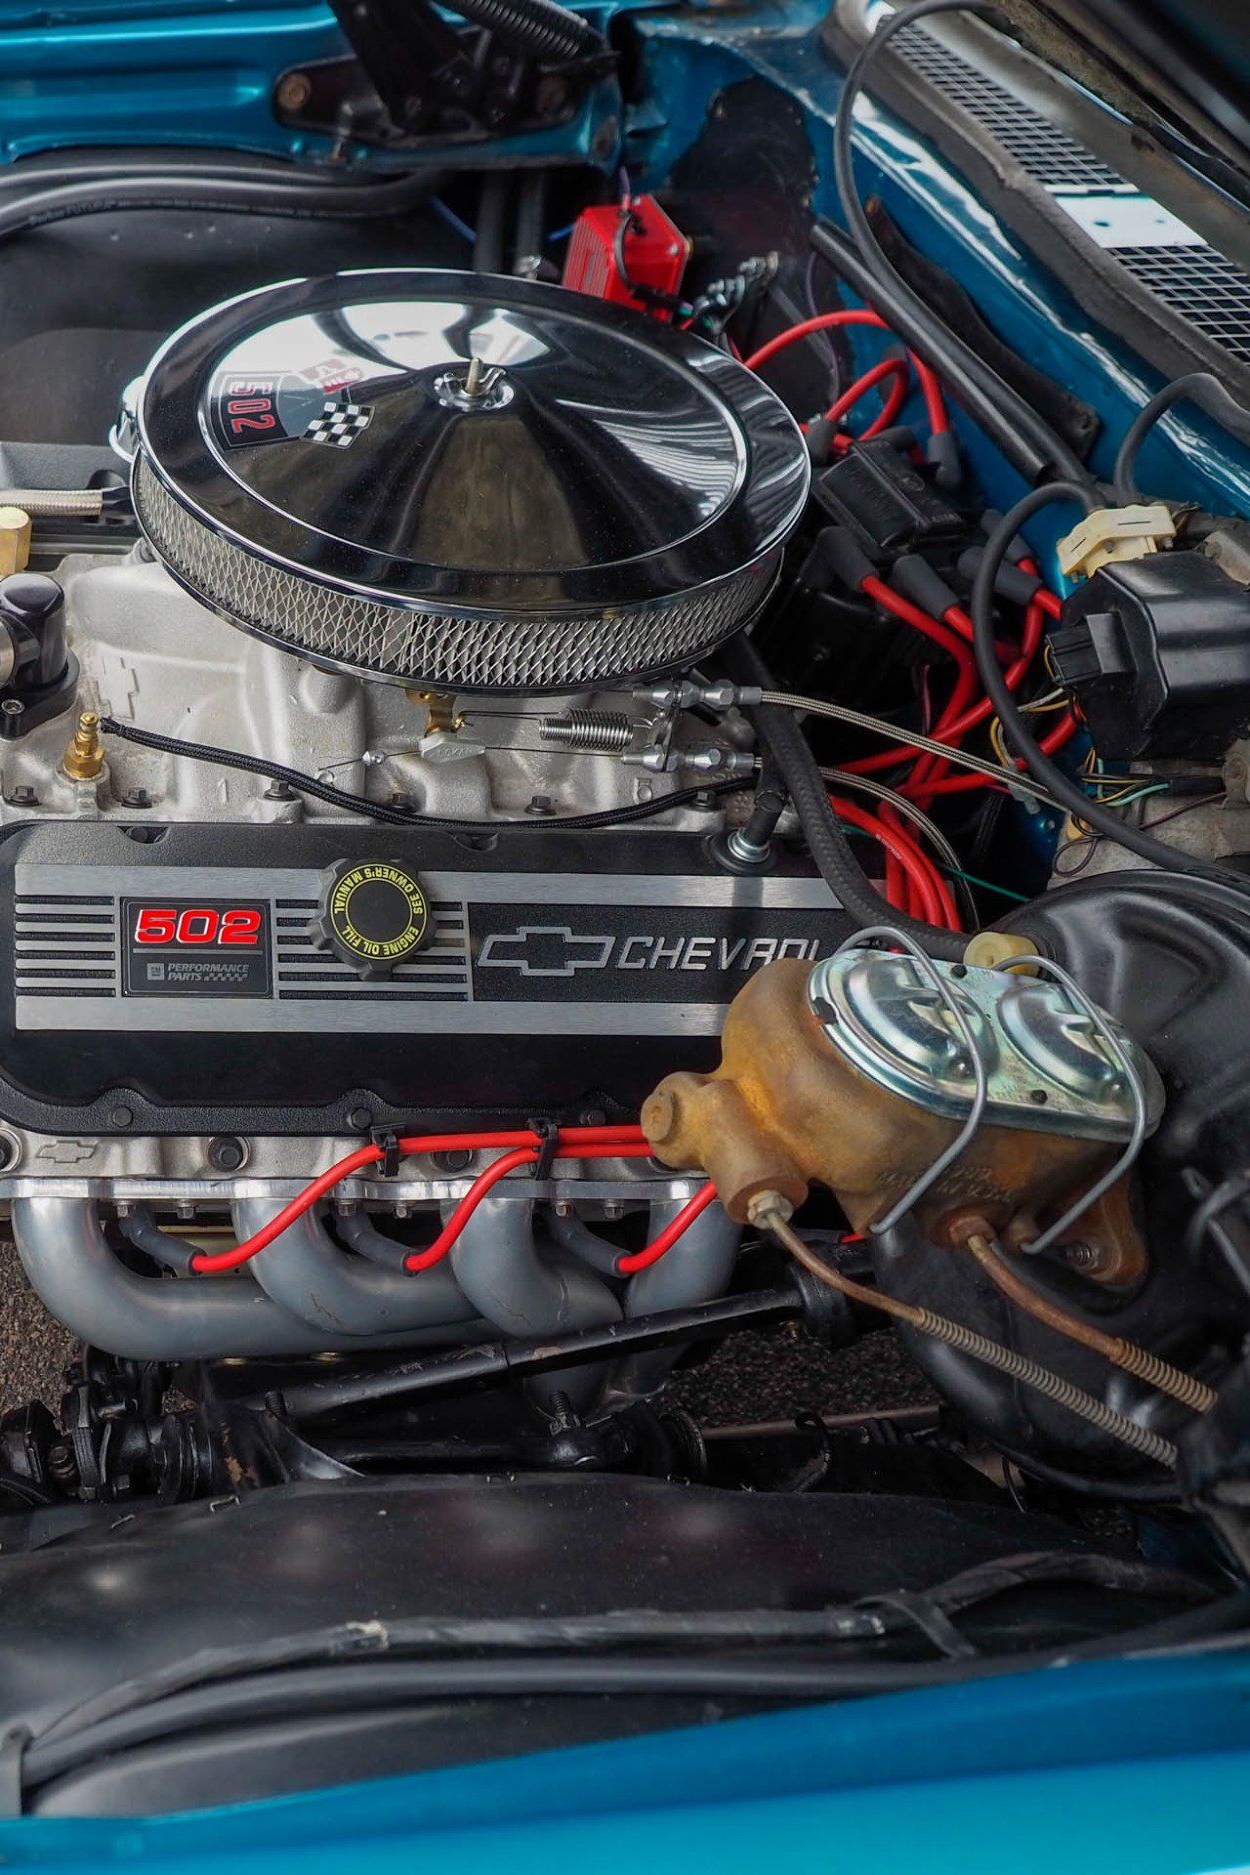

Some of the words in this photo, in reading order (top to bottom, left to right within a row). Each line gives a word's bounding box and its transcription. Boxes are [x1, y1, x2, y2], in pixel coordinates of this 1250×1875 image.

[228, 382, 275, 433] 502
[335, 871, 363, 914] MANUAL
[364, 867, 414, 893] OWNER'S
[410, 893, 423, 914] SEE
[135, 909, 261, 944] 502
[342, 925, 362, 947] FILL
[363, 941, 380, 955] OIL
[383, 926, 419, 955] ENGINE
[617, 937, 820, 970] CHEVRO
[167, 963, 250, 973] PERFORMANCE
[167, 972, 202, 981] PARTS
